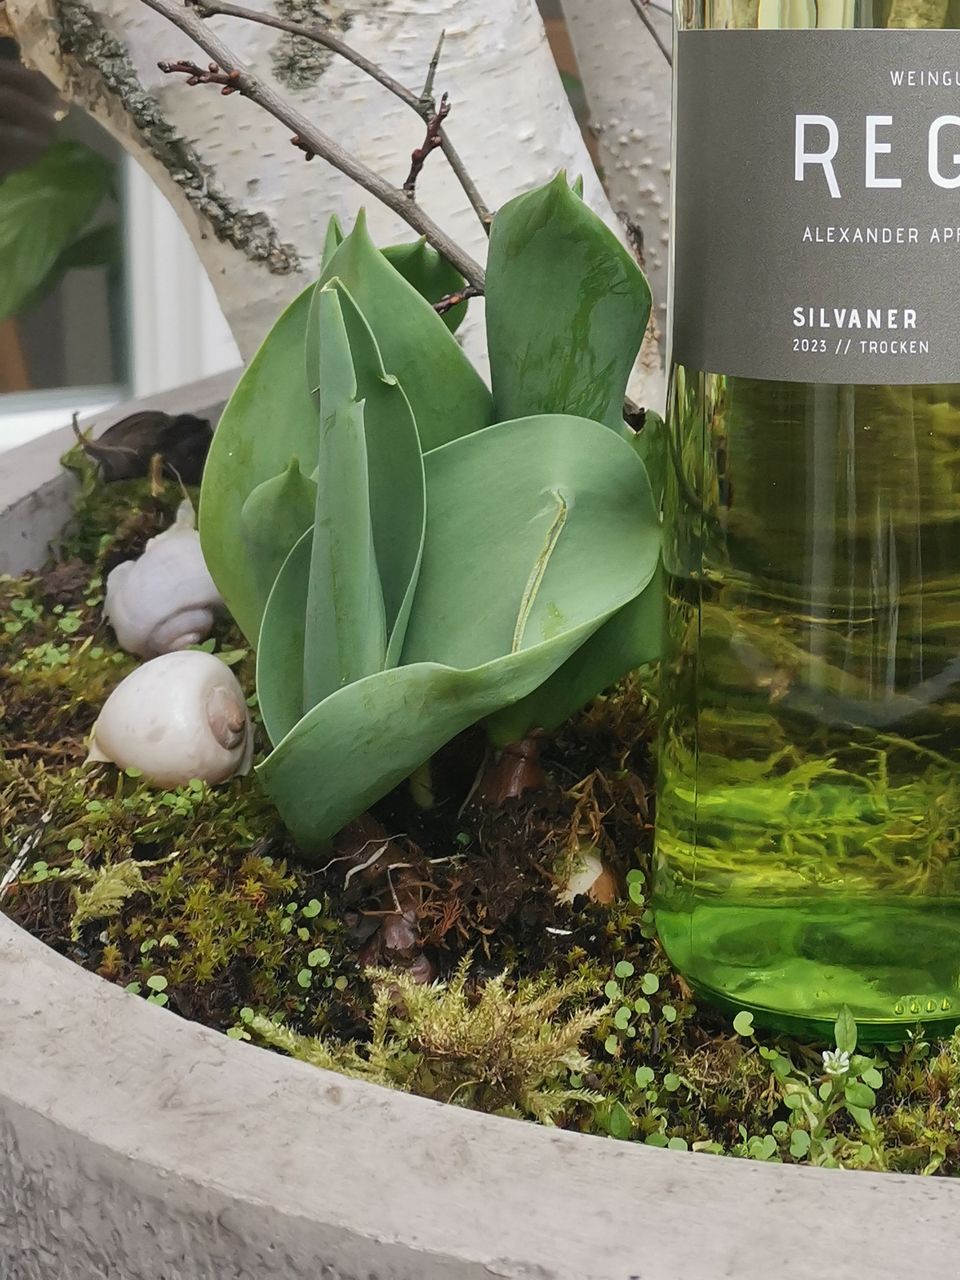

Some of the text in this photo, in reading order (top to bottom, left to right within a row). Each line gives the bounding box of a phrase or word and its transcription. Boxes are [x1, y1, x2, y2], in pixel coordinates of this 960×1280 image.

[802, 226, 919, 244] ALEXANDER
[792, 306, 917, 329] SILVANER
[792, 338, 827, 353] 2023
[859, 340, 929, 354] TROCKEN
